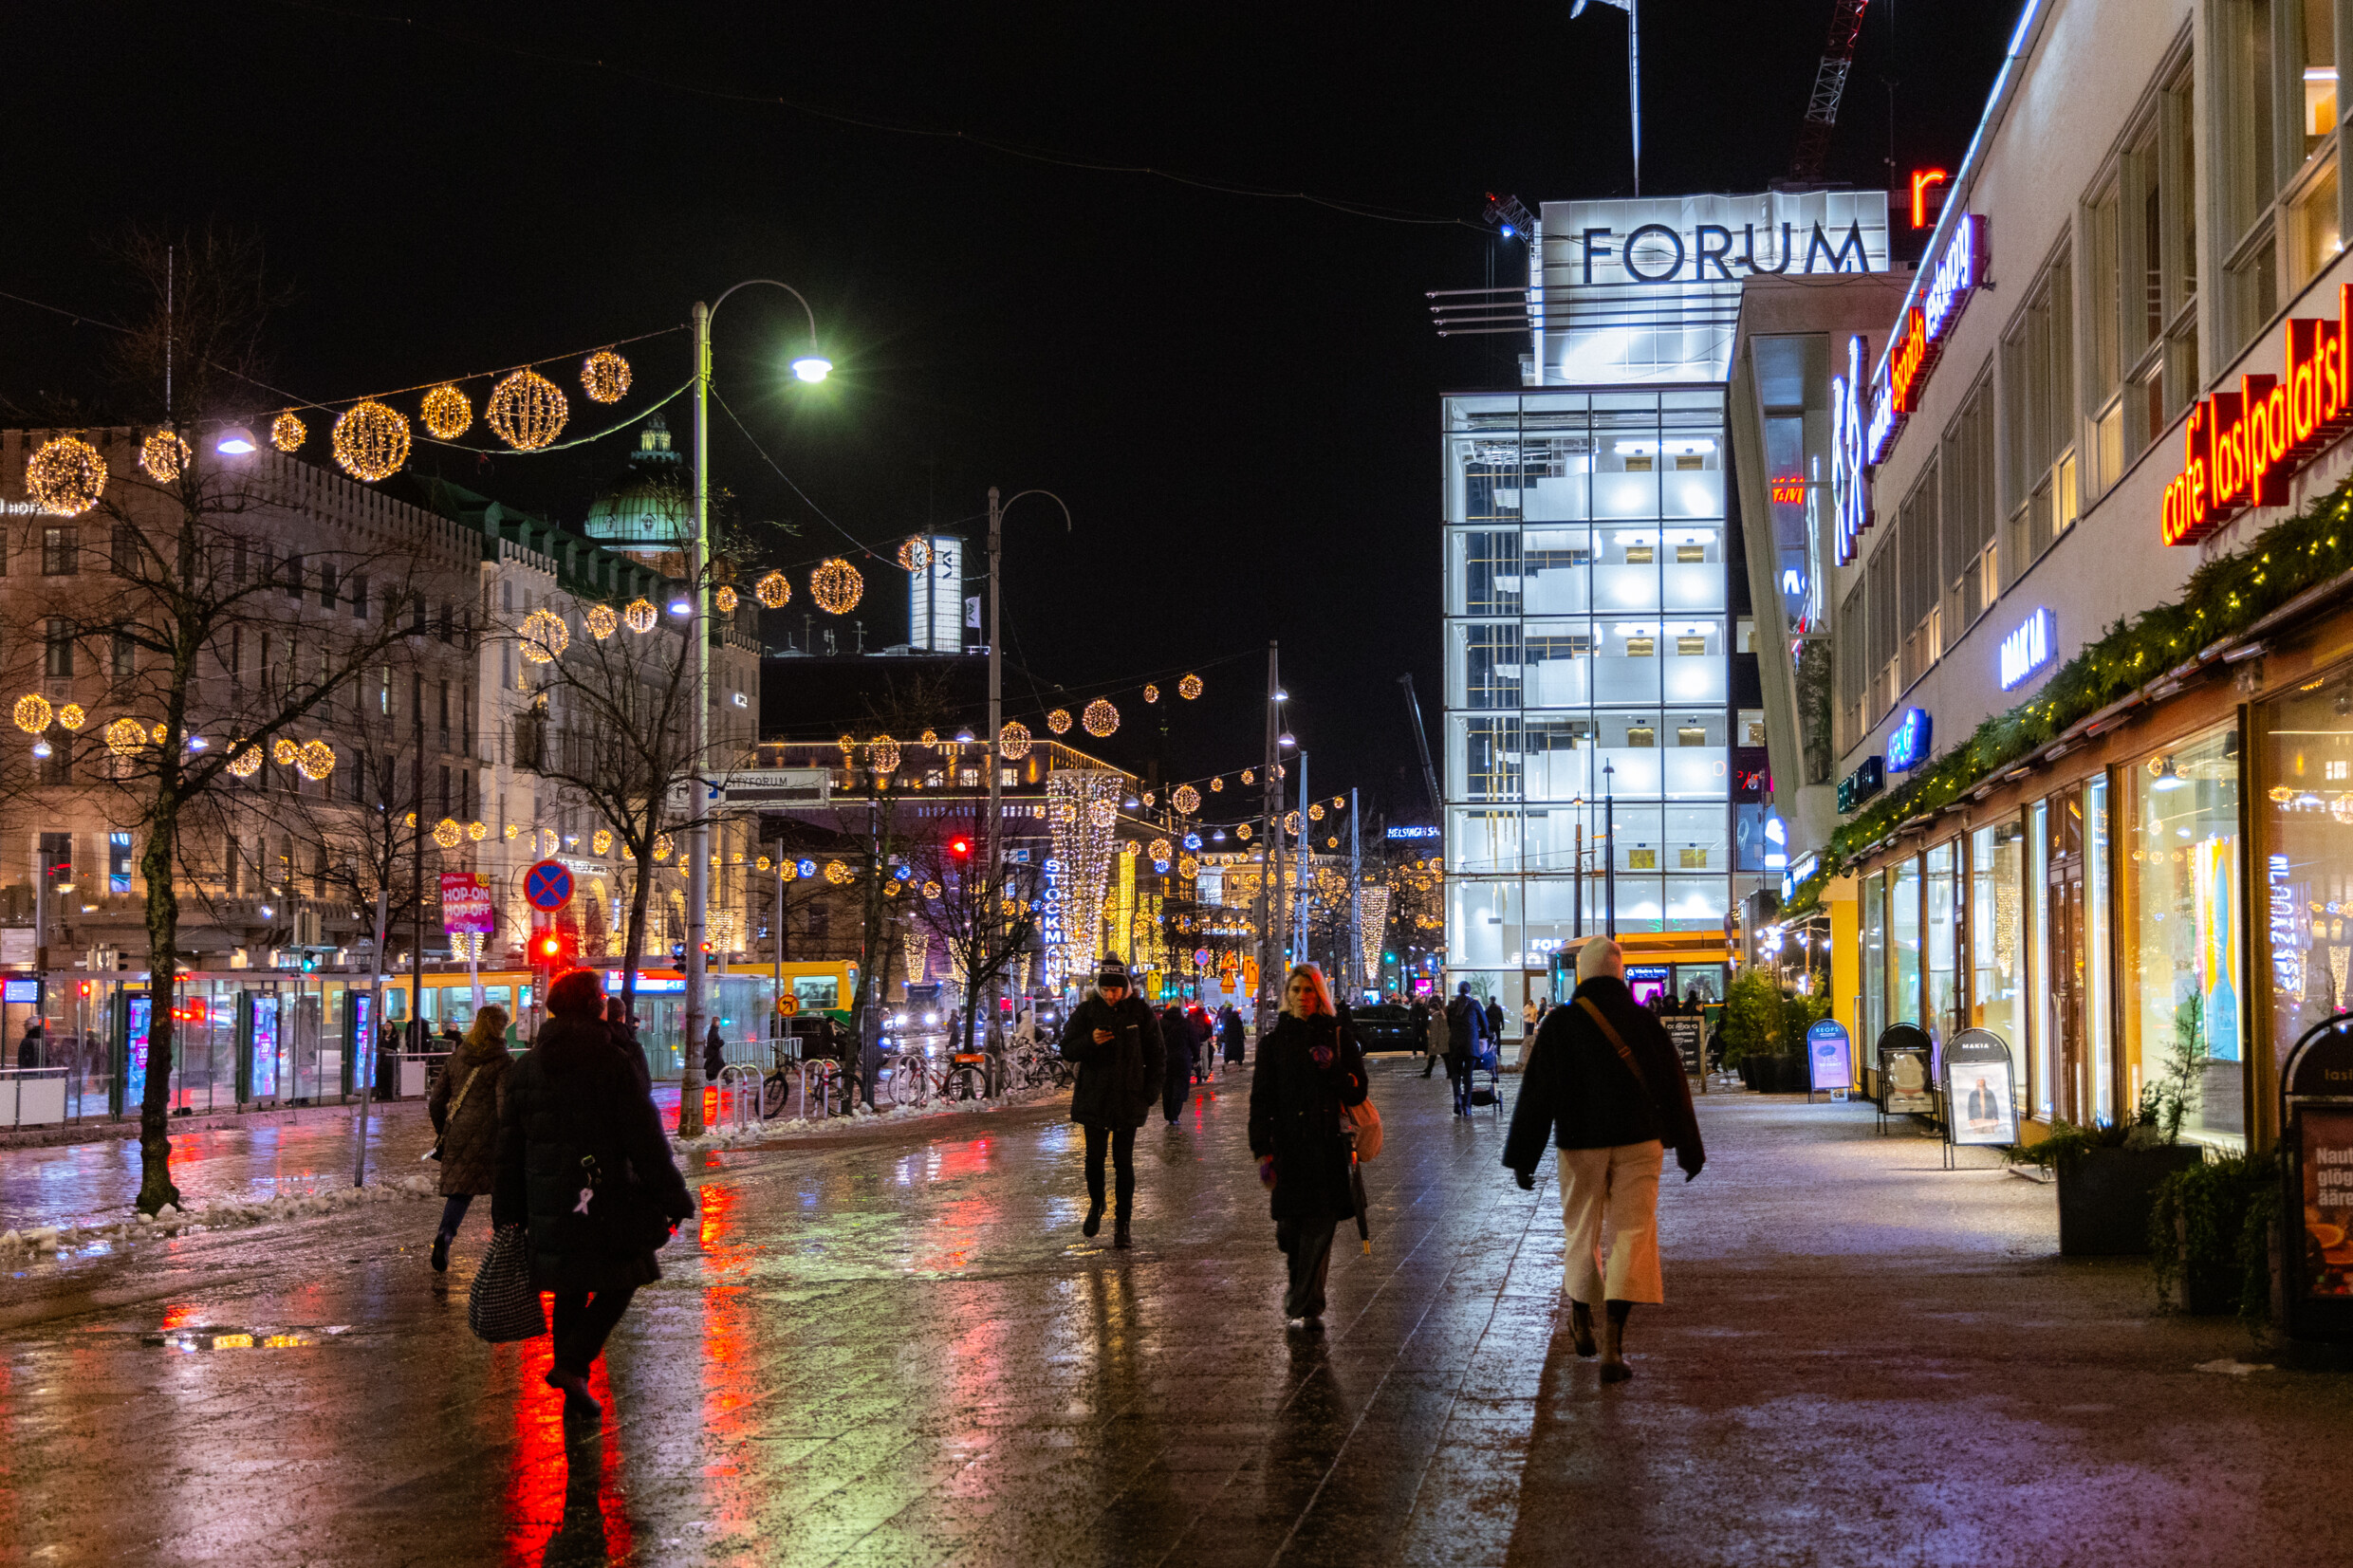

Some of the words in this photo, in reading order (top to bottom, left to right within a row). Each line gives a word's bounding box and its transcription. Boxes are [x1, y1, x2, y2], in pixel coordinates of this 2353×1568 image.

[1583, 217, 1870, 284] FORUM
[1925, 213, 1973, 342] restaurang
[2161, 400, 2205, 547] café
[2209, 283, 2349, 509] lasipalatsi
[2000, 607, 2047, 690] MAKIA
[725, 776, 787, 788] CITYFORUM
[442, 887, 490, 901] HOP-ON
[444, 903, 491, 917] HOP-OFF
[477, 874, 489, 884] 20
[1045, 858, 1062, 987] STOCKMANN
